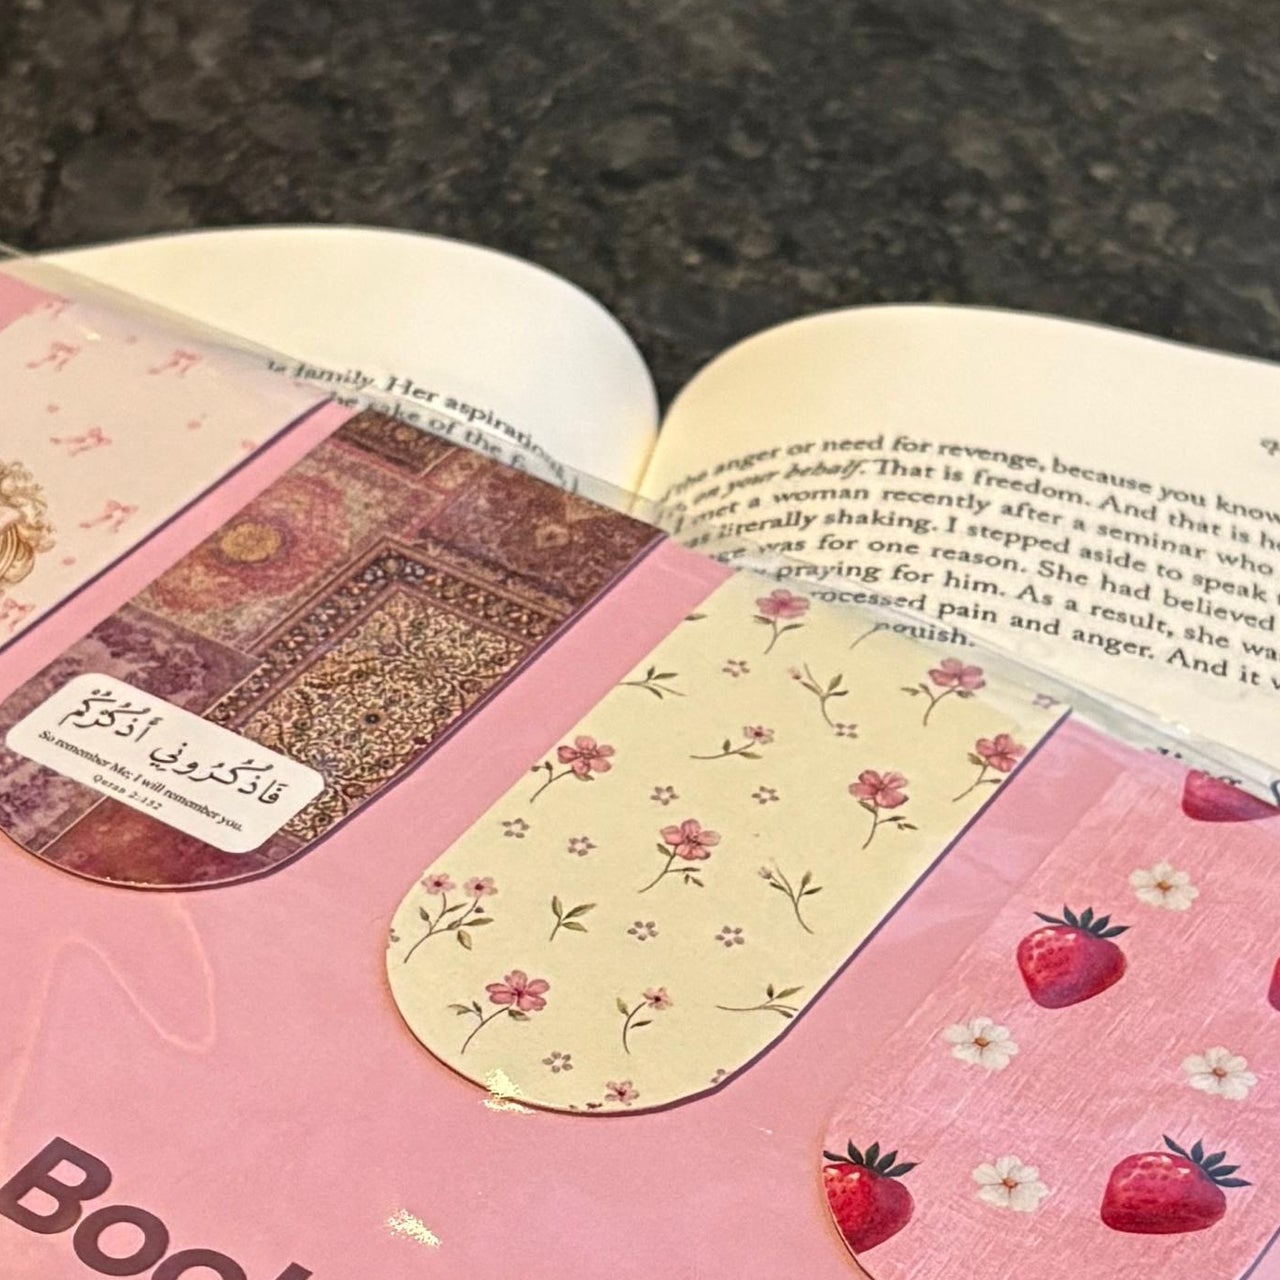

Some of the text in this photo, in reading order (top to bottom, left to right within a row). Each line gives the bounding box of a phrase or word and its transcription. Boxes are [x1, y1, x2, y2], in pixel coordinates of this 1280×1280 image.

[714, 448, 779, 475] anger
[787, 442, 816, 456] or
[822, 434, 884, 452] need
[891, 436, 932, 453] for
[938, 444, 1045, 472] revenge,
[1052, 456, 1152, 494] because
[1158, 486, 1206, 507] you
[817, 533, 859, 551] for
[867, 540, 920, 555] one
[931, 547, 1026, 573] reason.
[1037, 560, 1089, 586] She
[1100, 573, 1151, 601] had
[1163, 588, 1275, 632] believed
[38, 730, 56, 742] So
[54, 738, 112, 768] remember
[141, 778, 167, 794] will
[163, 789, 222, 821] remember
